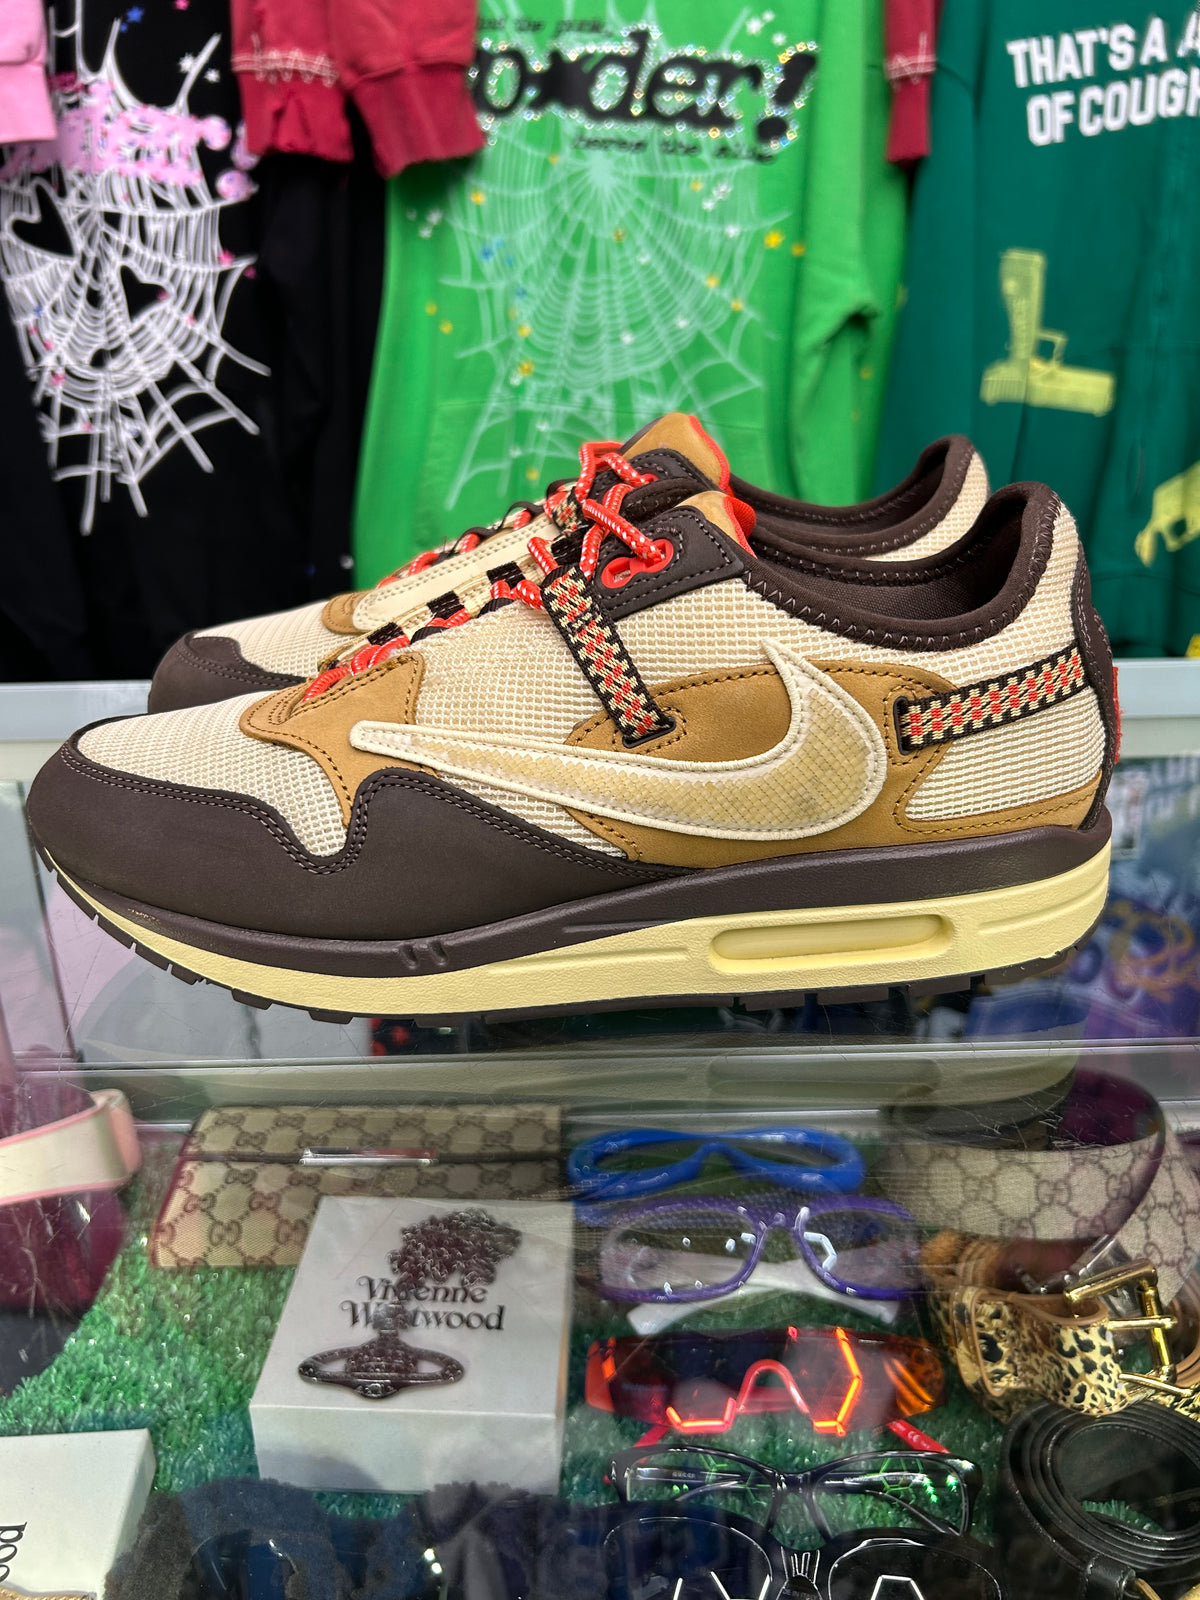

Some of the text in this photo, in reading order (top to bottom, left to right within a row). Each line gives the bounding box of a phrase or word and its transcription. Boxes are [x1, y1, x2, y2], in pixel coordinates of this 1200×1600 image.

[1006, 23, 1136, 88] THAT'S
[1139, 16, 1168, 65] A
[1026, 90, 1075, 146] OF
[356, 1275, 488, 1304] Vivenne
[341, 1300, 505, 1331] Wtwood
